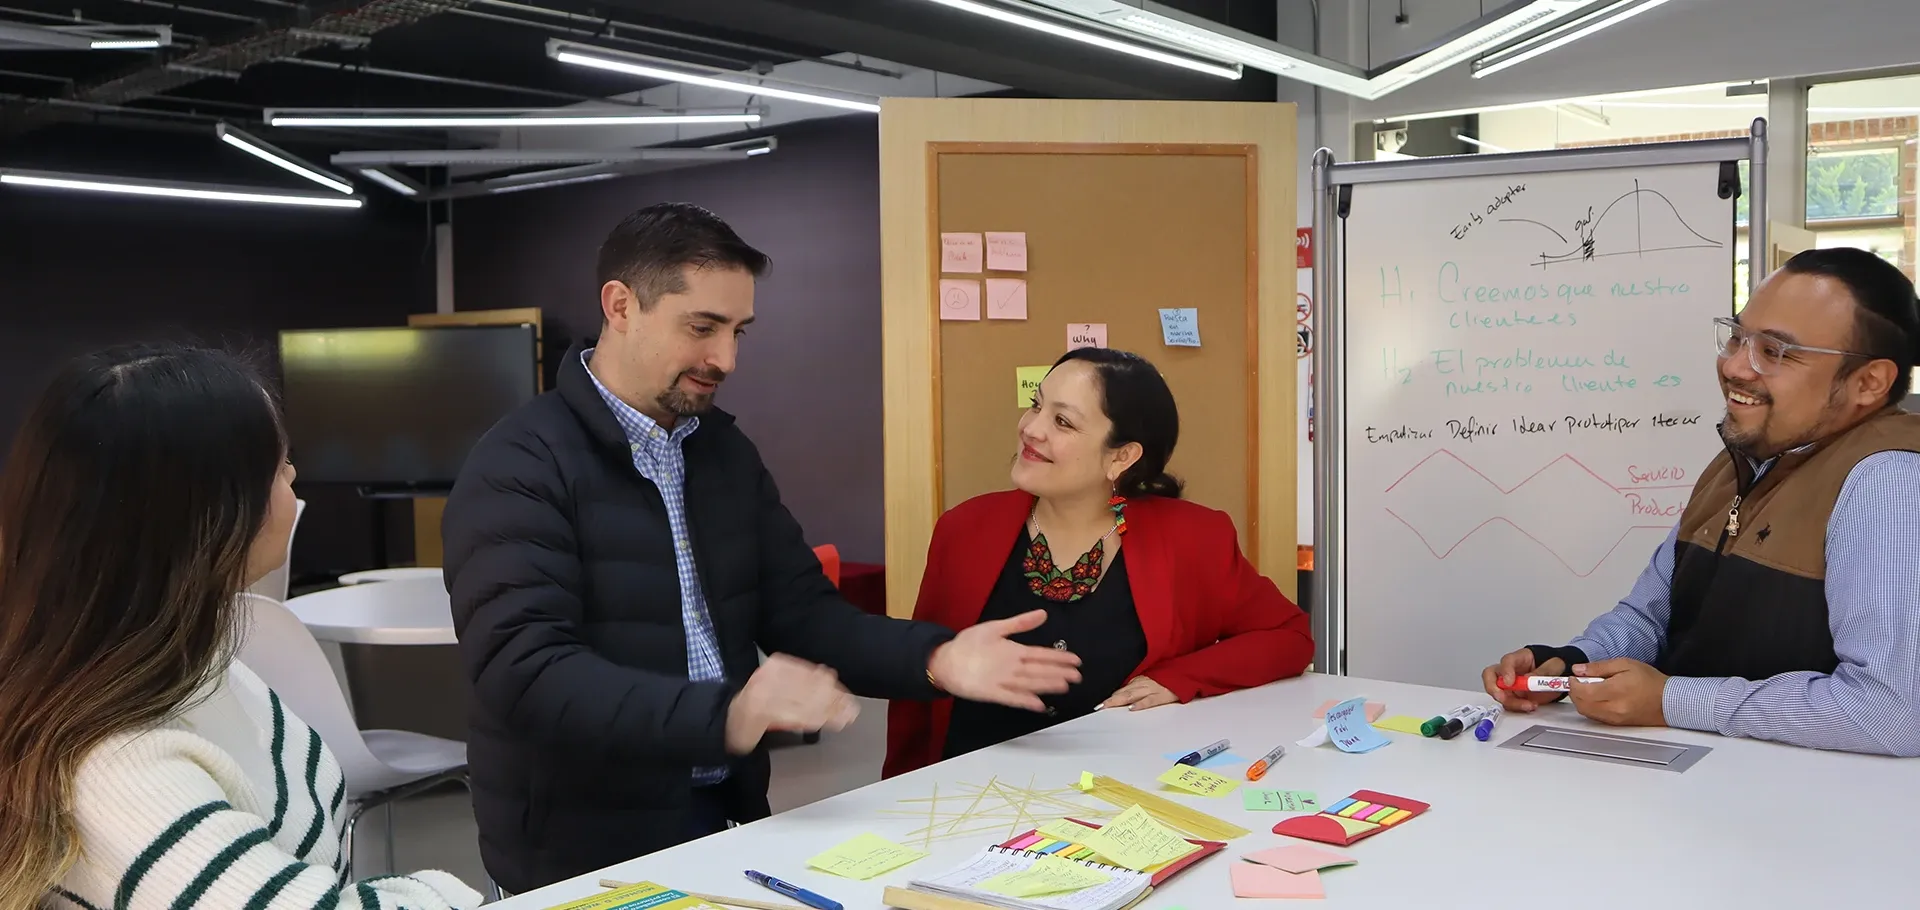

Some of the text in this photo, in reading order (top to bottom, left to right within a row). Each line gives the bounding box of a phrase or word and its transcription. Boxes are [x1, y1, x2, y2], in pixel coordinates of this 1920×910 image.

[1450, 183, 1527, 240] Early adopter
[1610, 276, 1691, 298] nuestro
[1430, 348, 1465, 375] El
[1603, 349, 1631, 369] de
[1445, 376, 1533, 398] nuestro
[1652, 373, 1683, 388] es
[1446, 416, 1498, 443] Definir
[1624, 492, 1685, 517] Product
